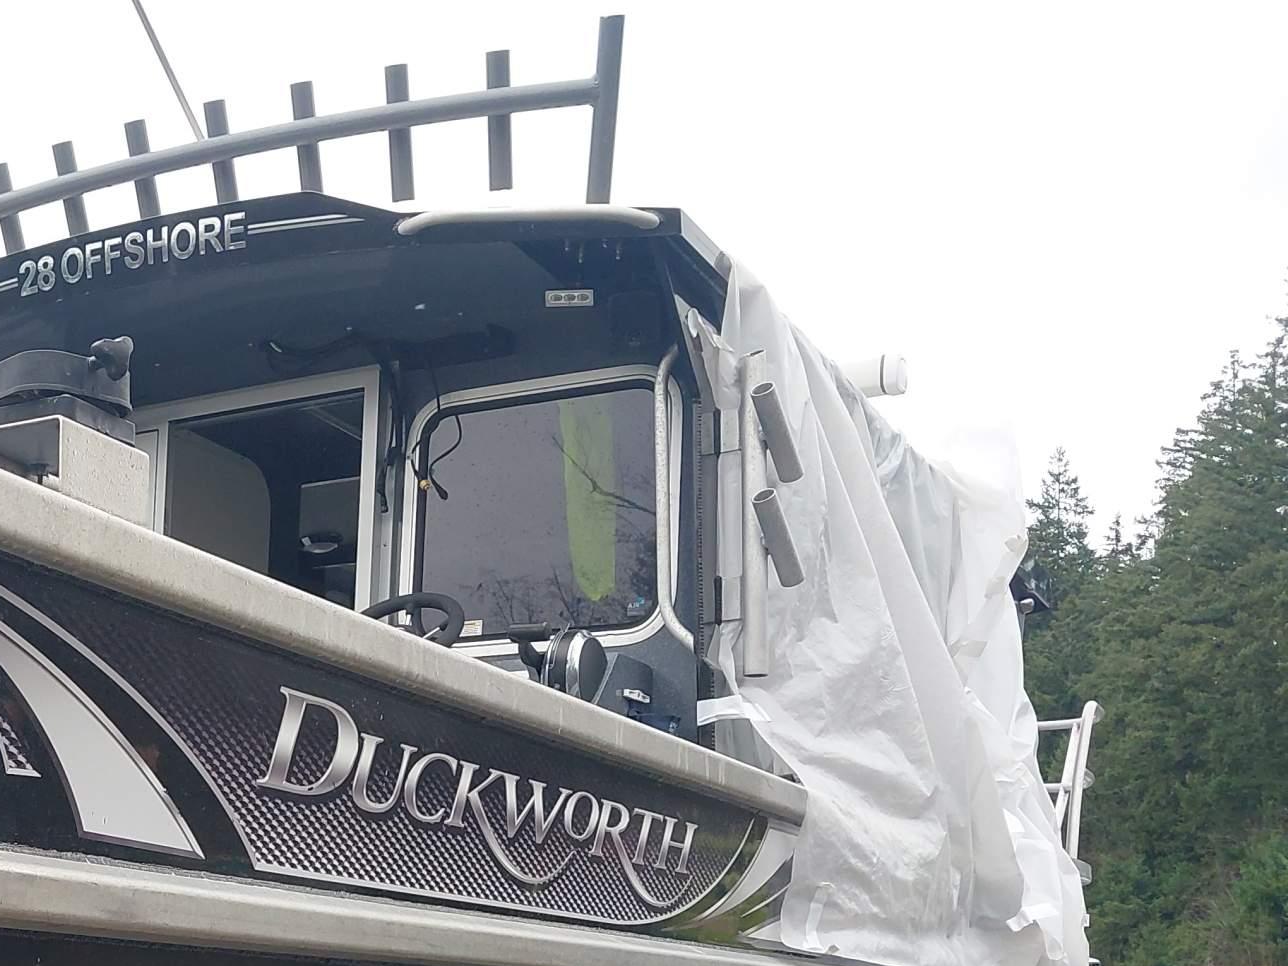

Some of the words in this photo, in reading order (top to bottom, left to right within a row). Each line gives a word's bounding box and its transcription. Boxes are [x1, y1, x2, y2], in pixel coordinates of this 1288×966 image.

[18, 255, 56, 297] 28
[60, 211, 247, 284] OFFSHORE
[255, 685, 699, 908] DUCKWORTH
